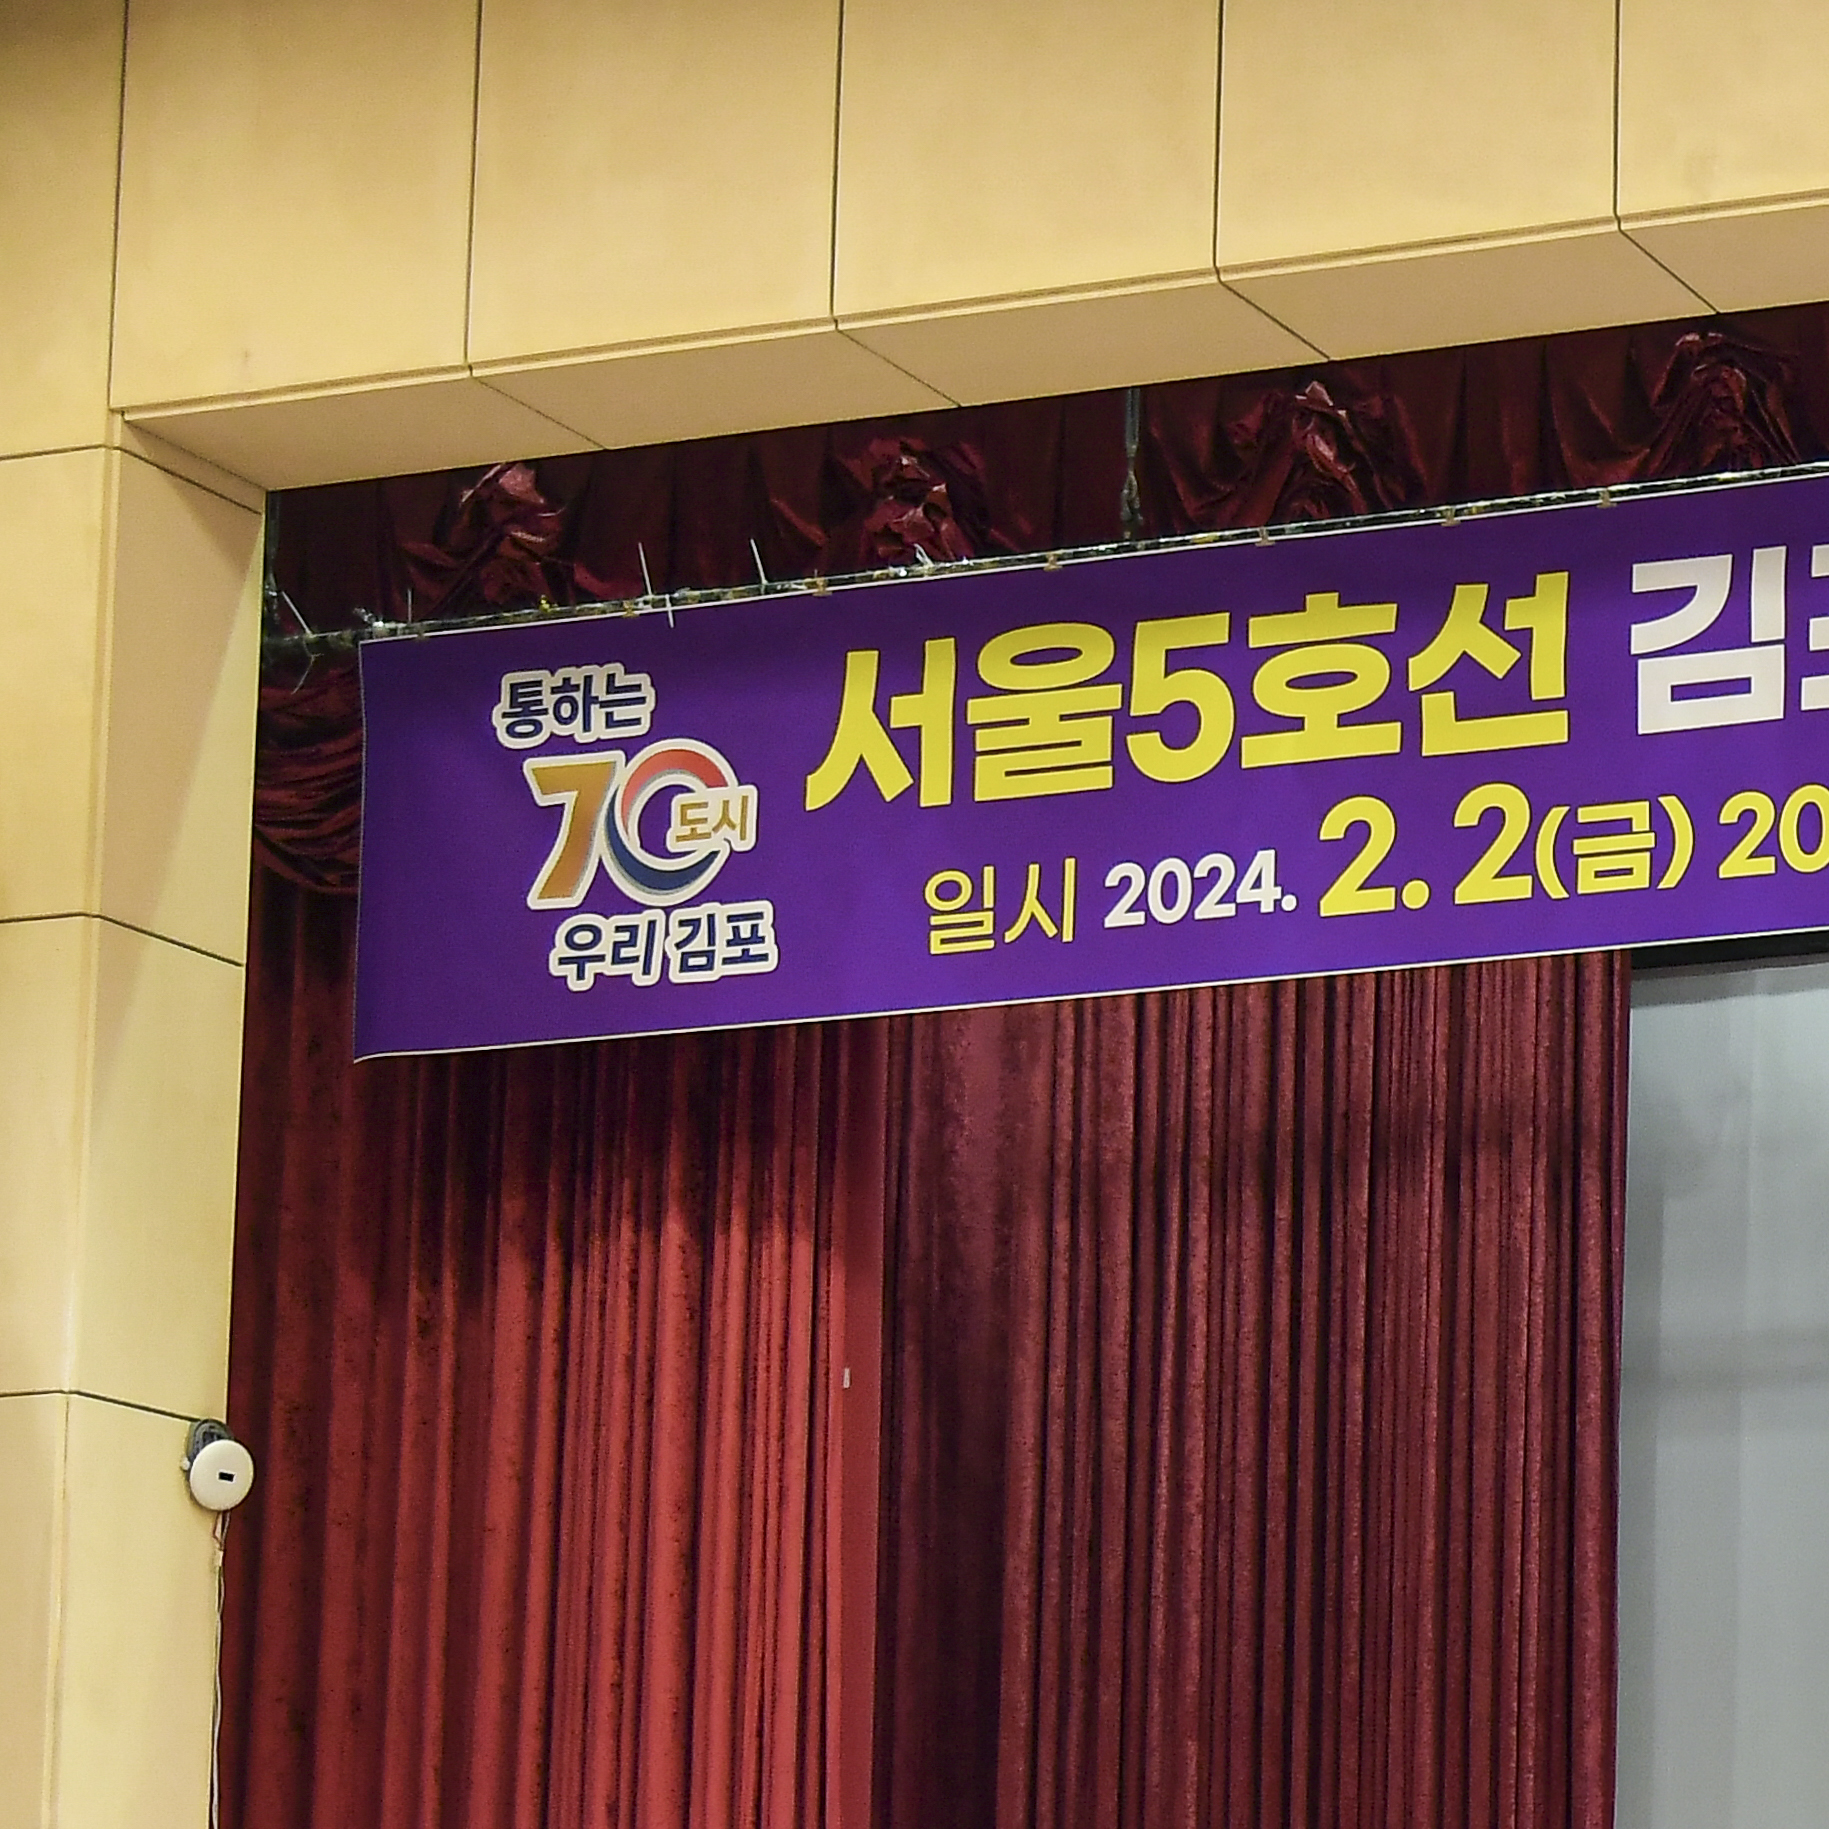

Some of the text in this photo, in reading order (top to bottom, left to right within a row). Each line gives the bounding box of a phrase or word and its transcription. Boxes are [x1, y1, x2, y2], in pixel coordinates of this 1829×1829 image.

[501, 673, 652, 739] 통하는
[805, 571, 1571, 811] 서울5호선
[675, 795, 749, 843] 도시
[925, 856, 1078, 956] 일시
[1102, 849, 1298, 930] 2024.
[557, 913, 769, 981] 우리 김포
